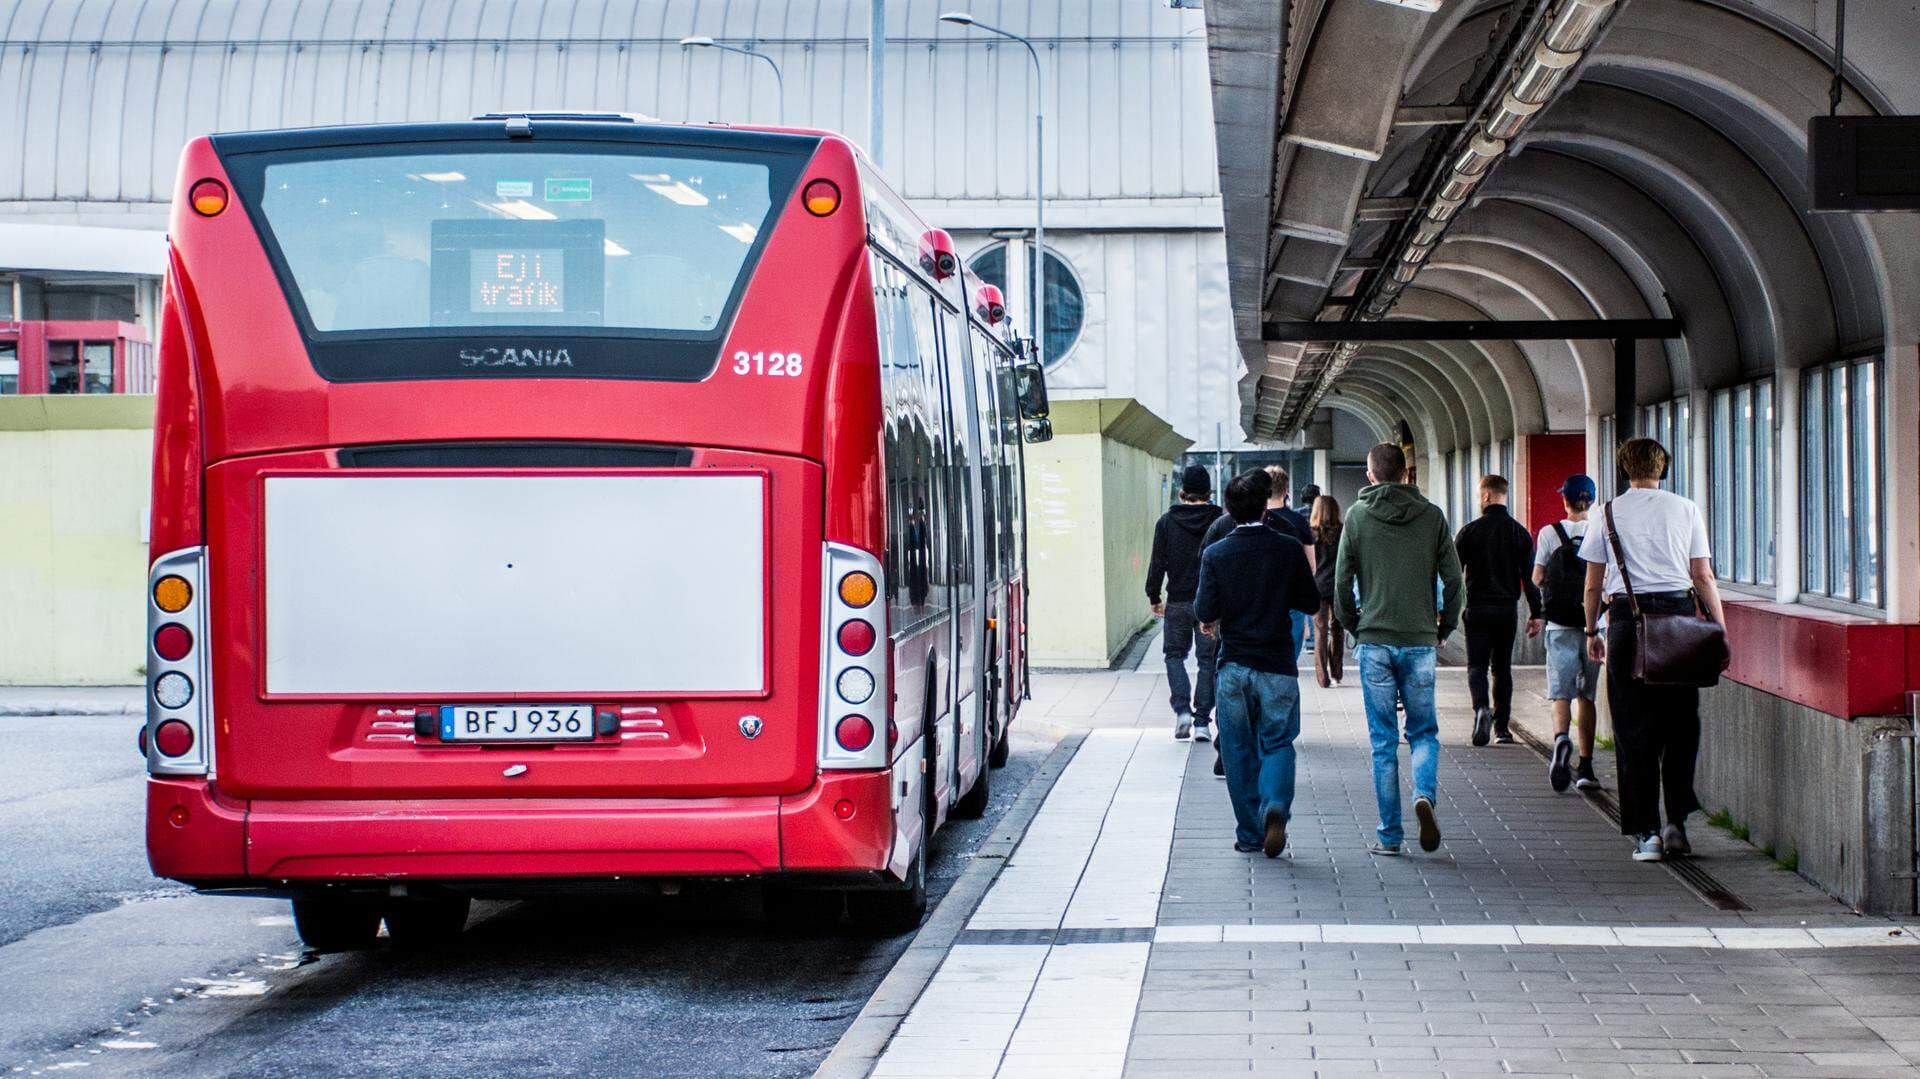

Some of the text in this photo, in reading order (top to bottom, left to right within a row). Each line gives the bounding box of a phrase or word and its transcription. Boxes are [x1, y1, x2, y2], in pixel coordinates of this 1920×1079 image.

[497, 253, 525, 282] Ej
[480, 281, 558, 305] trafik
[459, 347, 574, 367] SCANIA
[733, 351, 803, 377] 3128
[466, 709, 582, 734] BFJ 936
